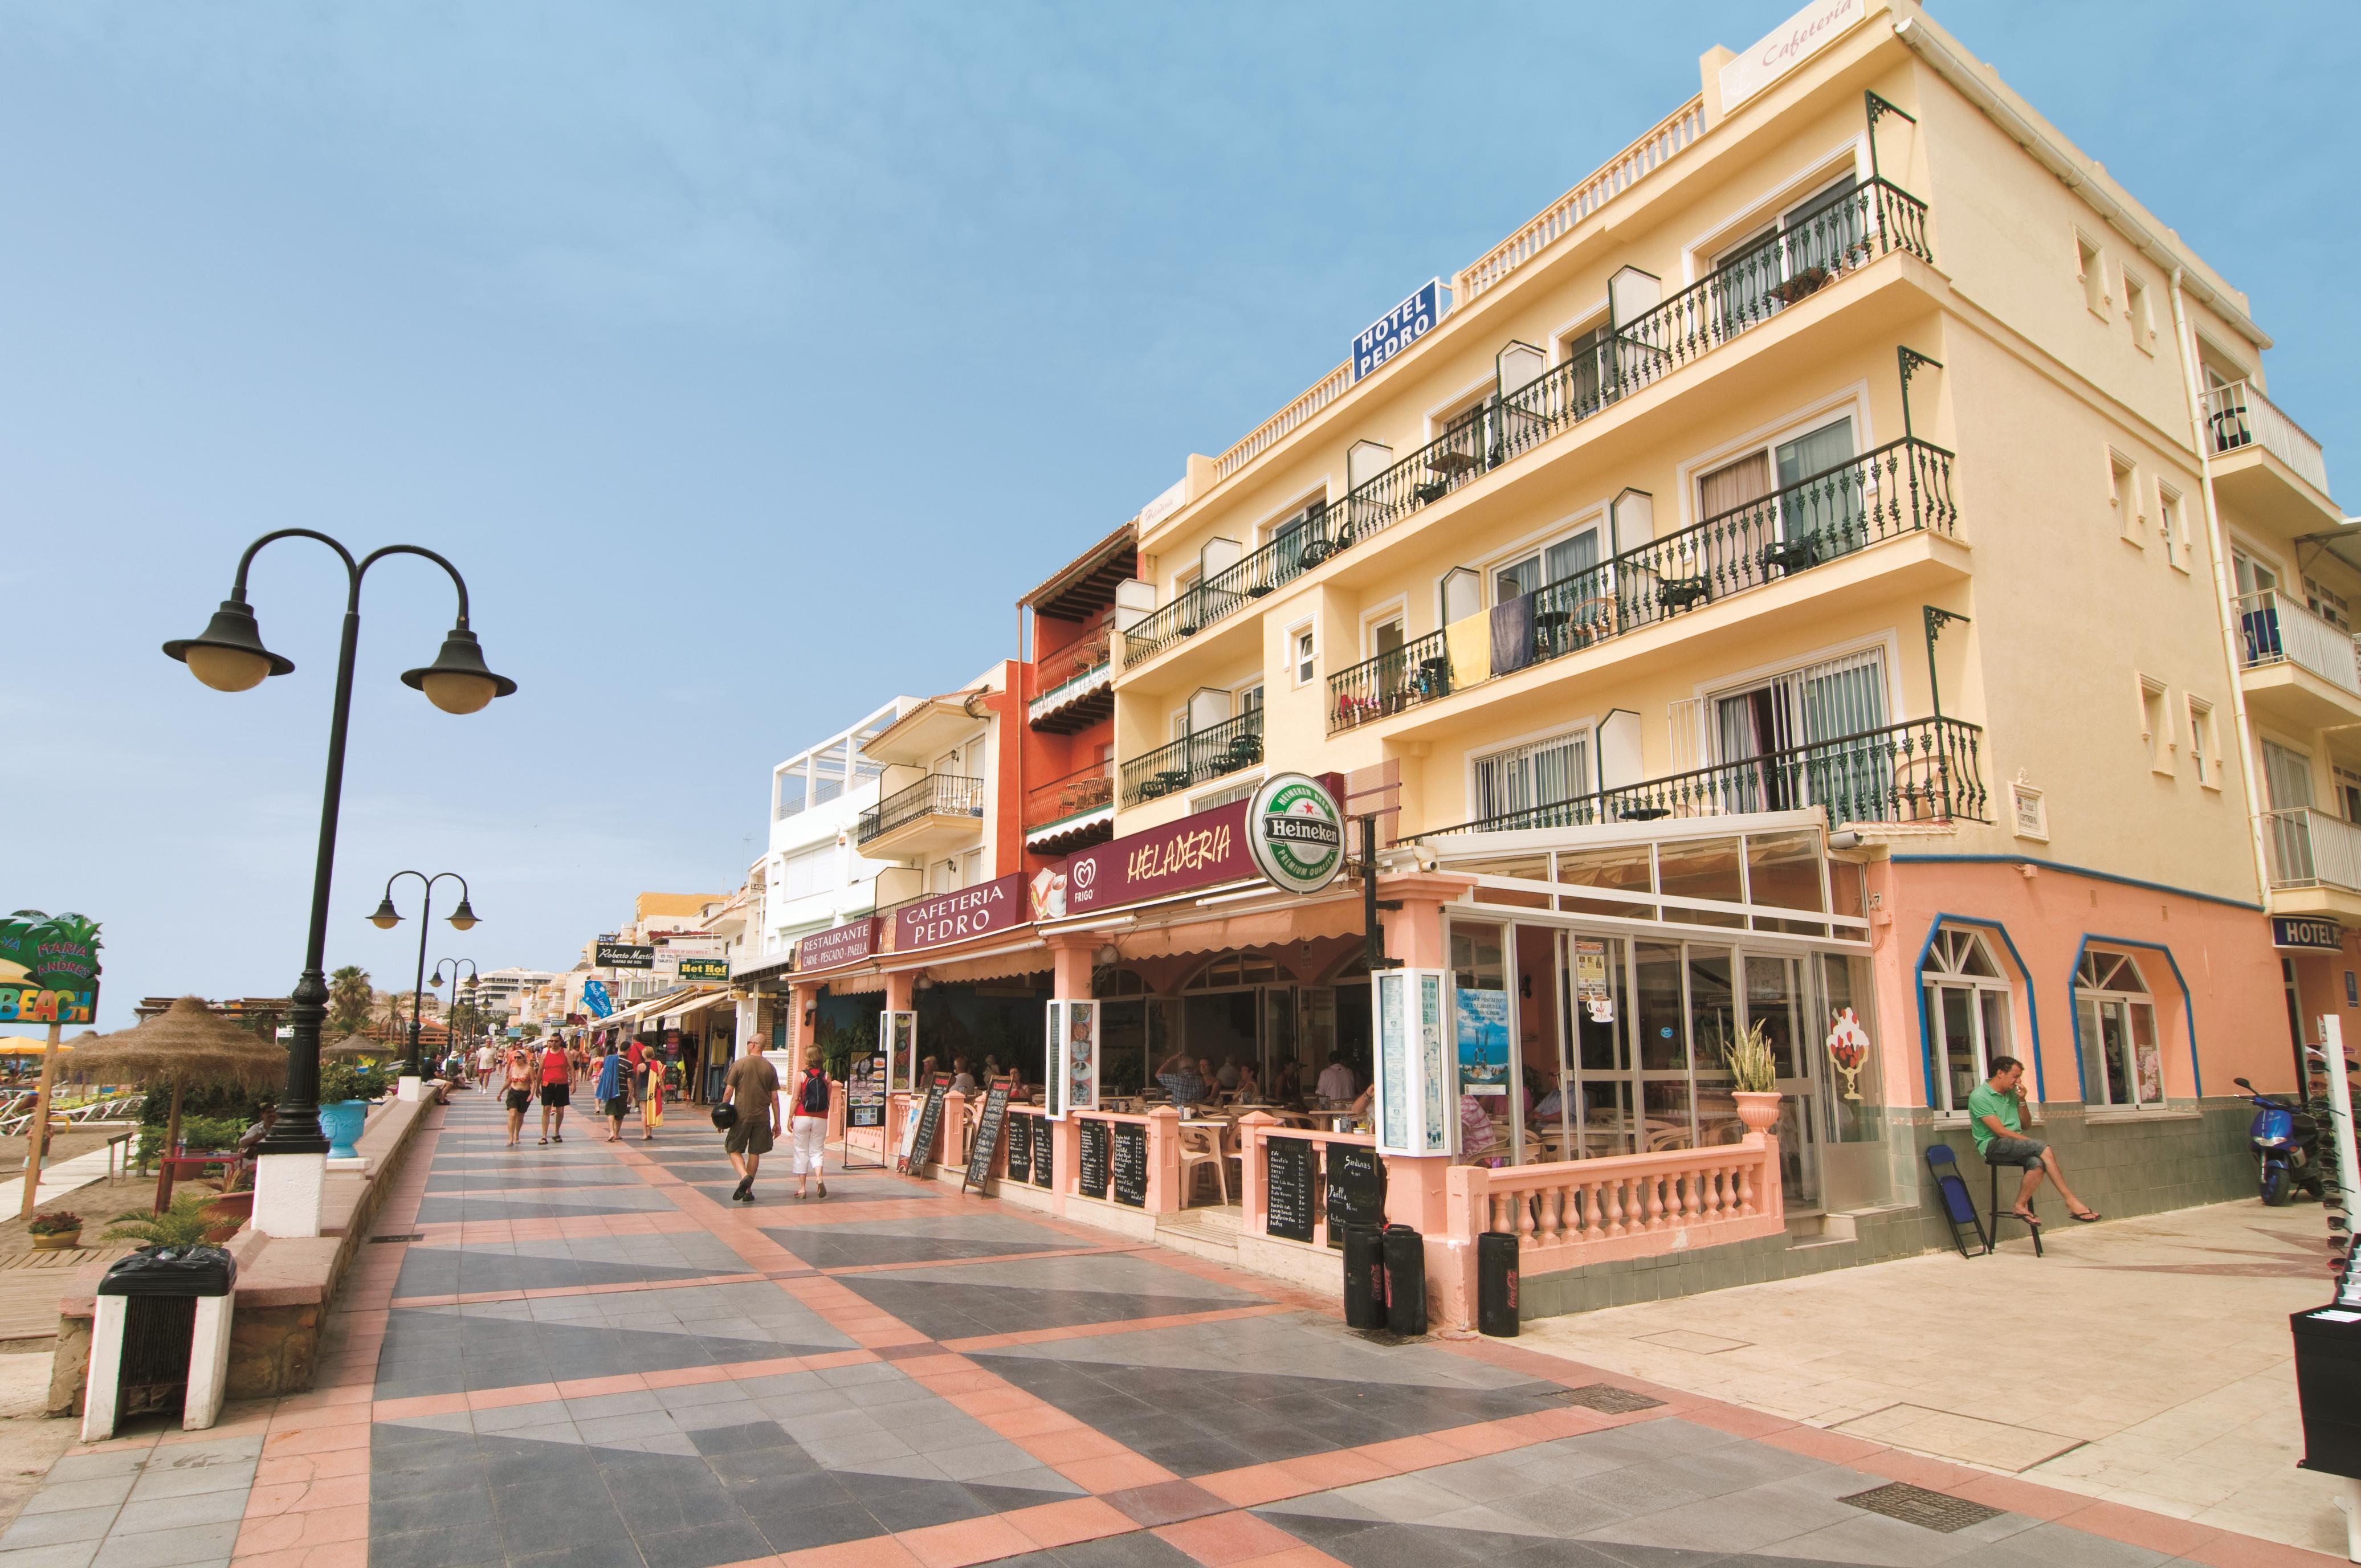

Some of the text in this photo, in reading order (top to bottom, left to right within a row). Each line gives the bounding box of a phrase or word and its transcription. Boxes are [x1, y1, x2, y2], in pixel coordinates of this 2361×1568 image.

[1362, 293, 1426, 353] HOTEL
[1360, 314, 1429, 377] PEDRO
[1277, 787, 1330, 812] HEINEKEN BEER
[1271, 819, 1338, 843] Heineken
[1127, 824, 1231, 884] HELADERIA
[1278, 849, 1334, 876] PREMIUM QUALITY
[906, 885, 1004, 924] CAFETERIA
[1075, 889, 1094, 903] FRIGO
[804, 924, 868, 952] RESTAURANTE
[914, 909, 989, 944] PEDRO
[2285, 922, 2332, 944] HOTEL
[37, 941, 88, 958] MARIA
[598, 948, 630, 959] Roberto
[803, 954, 818, 967] CARNE
[820, 948, 845, 963] PESCADO
[847, 942, 867, 957] PAELLA
[38, 960, 91, 978] ANDRES
[681, 964, 727, 973] Het Hof
[0, 987, 92, 1022] BEACH
[589, 982, 601, 997] Beach
[597, 997, 609, 1012] Lunch
[1344, 1155, 1371, 1170] Sardinas
[1328, 1184, 1347, 1200] Paella
